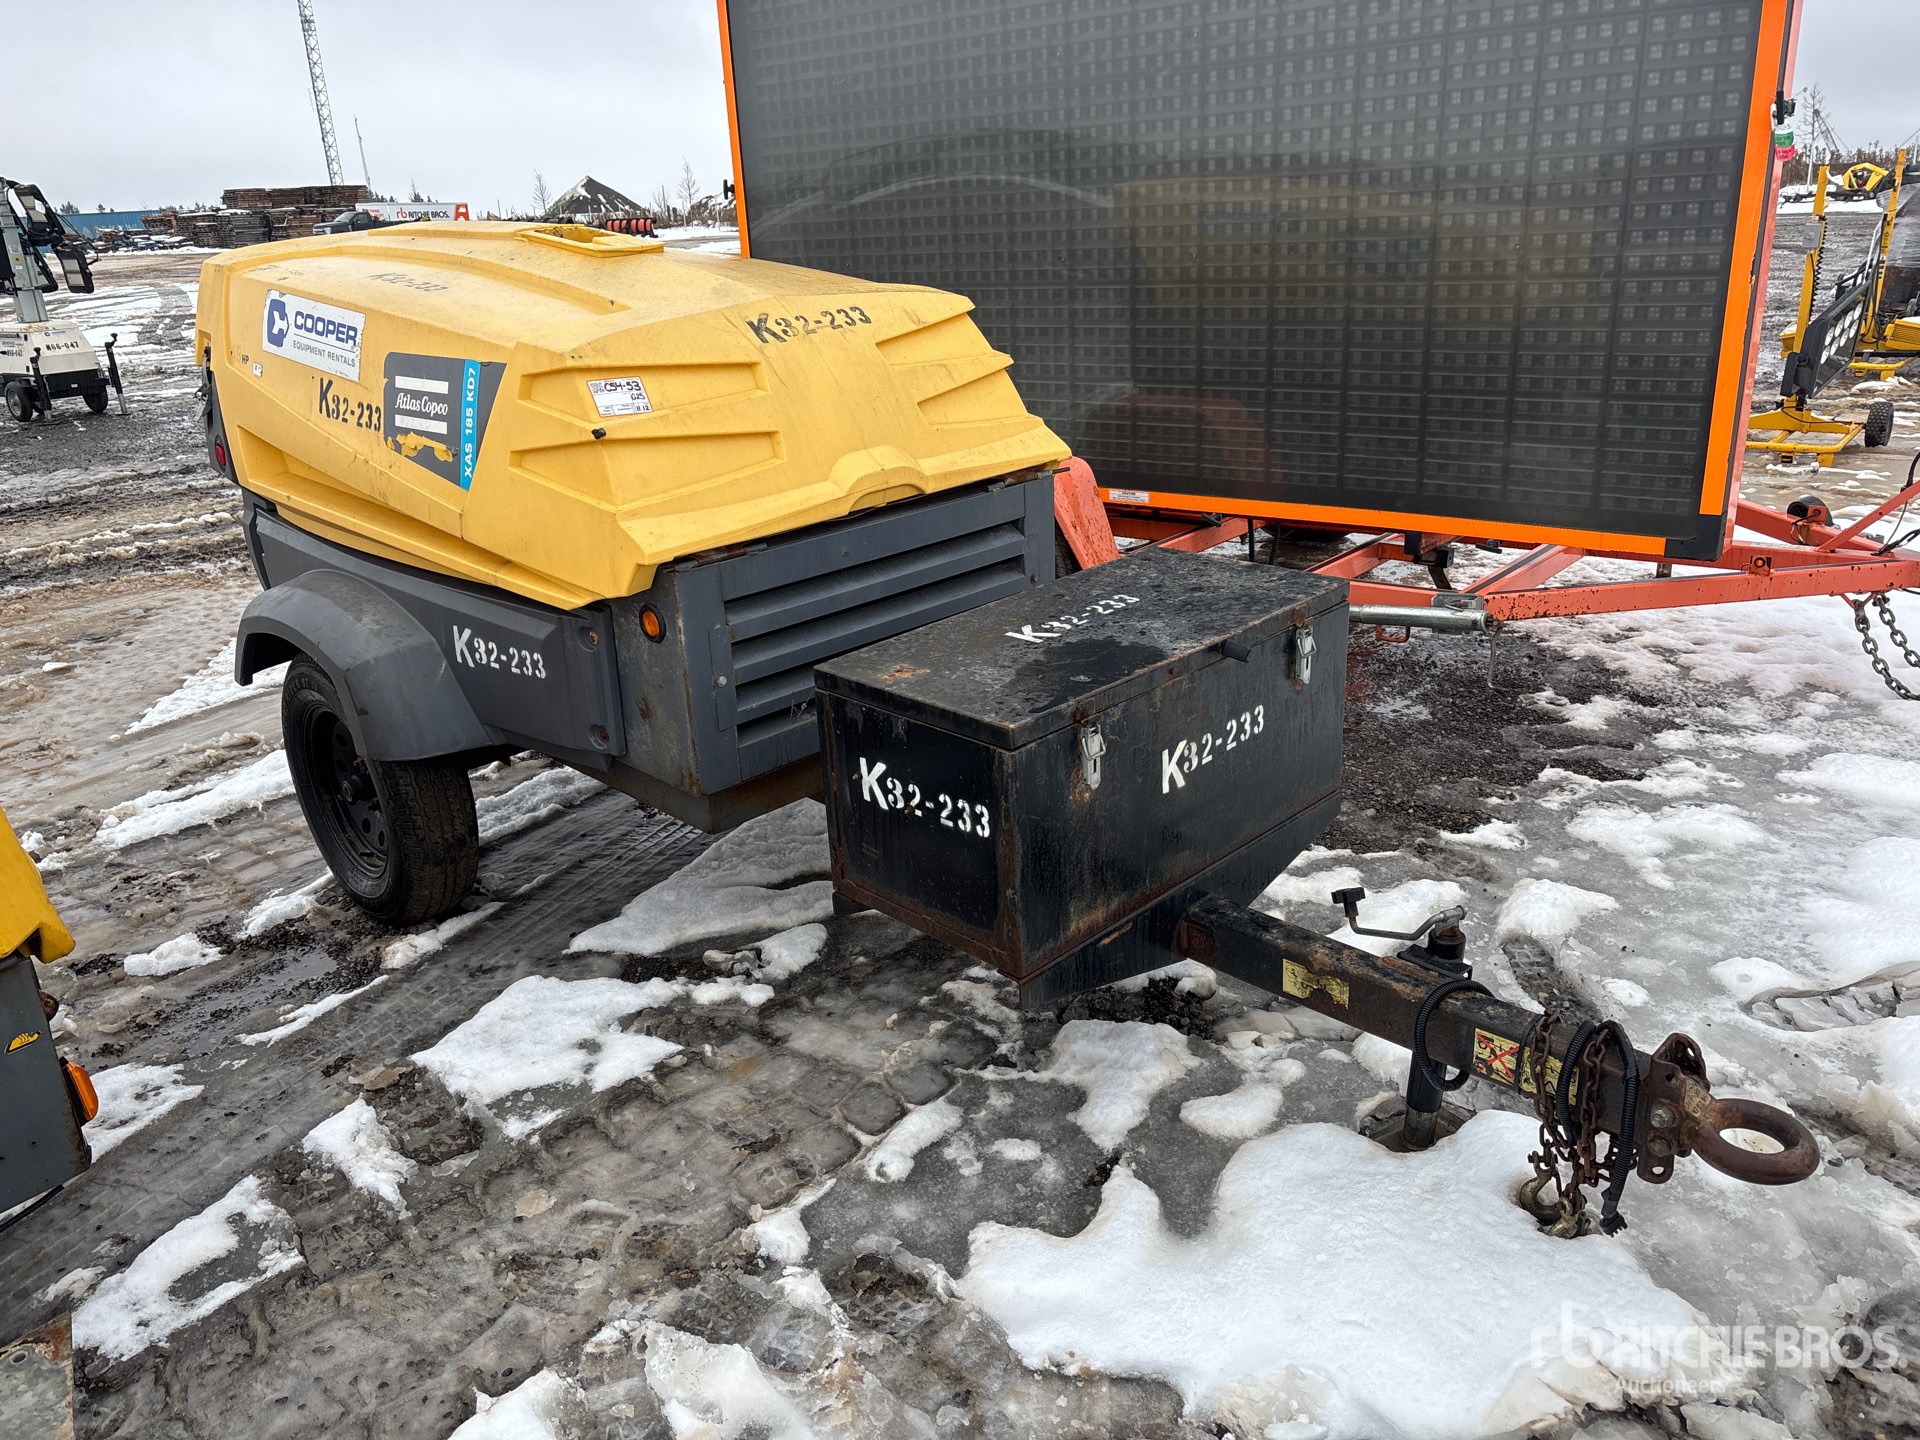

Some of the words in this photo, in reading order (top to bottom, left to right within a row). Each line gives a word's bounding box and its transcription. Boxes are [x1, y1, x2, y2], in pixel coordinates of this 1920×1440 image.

[294, 310, 358, 347] COOPER
[746, 306, 872, 344] K32-233
[293, 340, 326, 358] EQUIPMENT
[327, 351, 356, 367] RENTALS
[466, 367, 476, 402] KD7
[318, 377, 381, 433] K32-233
[394, 392, 421, 412] Atlas
[421, 396, 448, 417] Copco
[465, 407, 473, 436] 185
[464, 443, 473, 478] XAS
[1004, 594, 1140, 643] K32-233
[452, 625, 547, 680] K32-233
[1162, 705, 1264, 794] K32-233
[859, 757, 991, 838] K32-233
